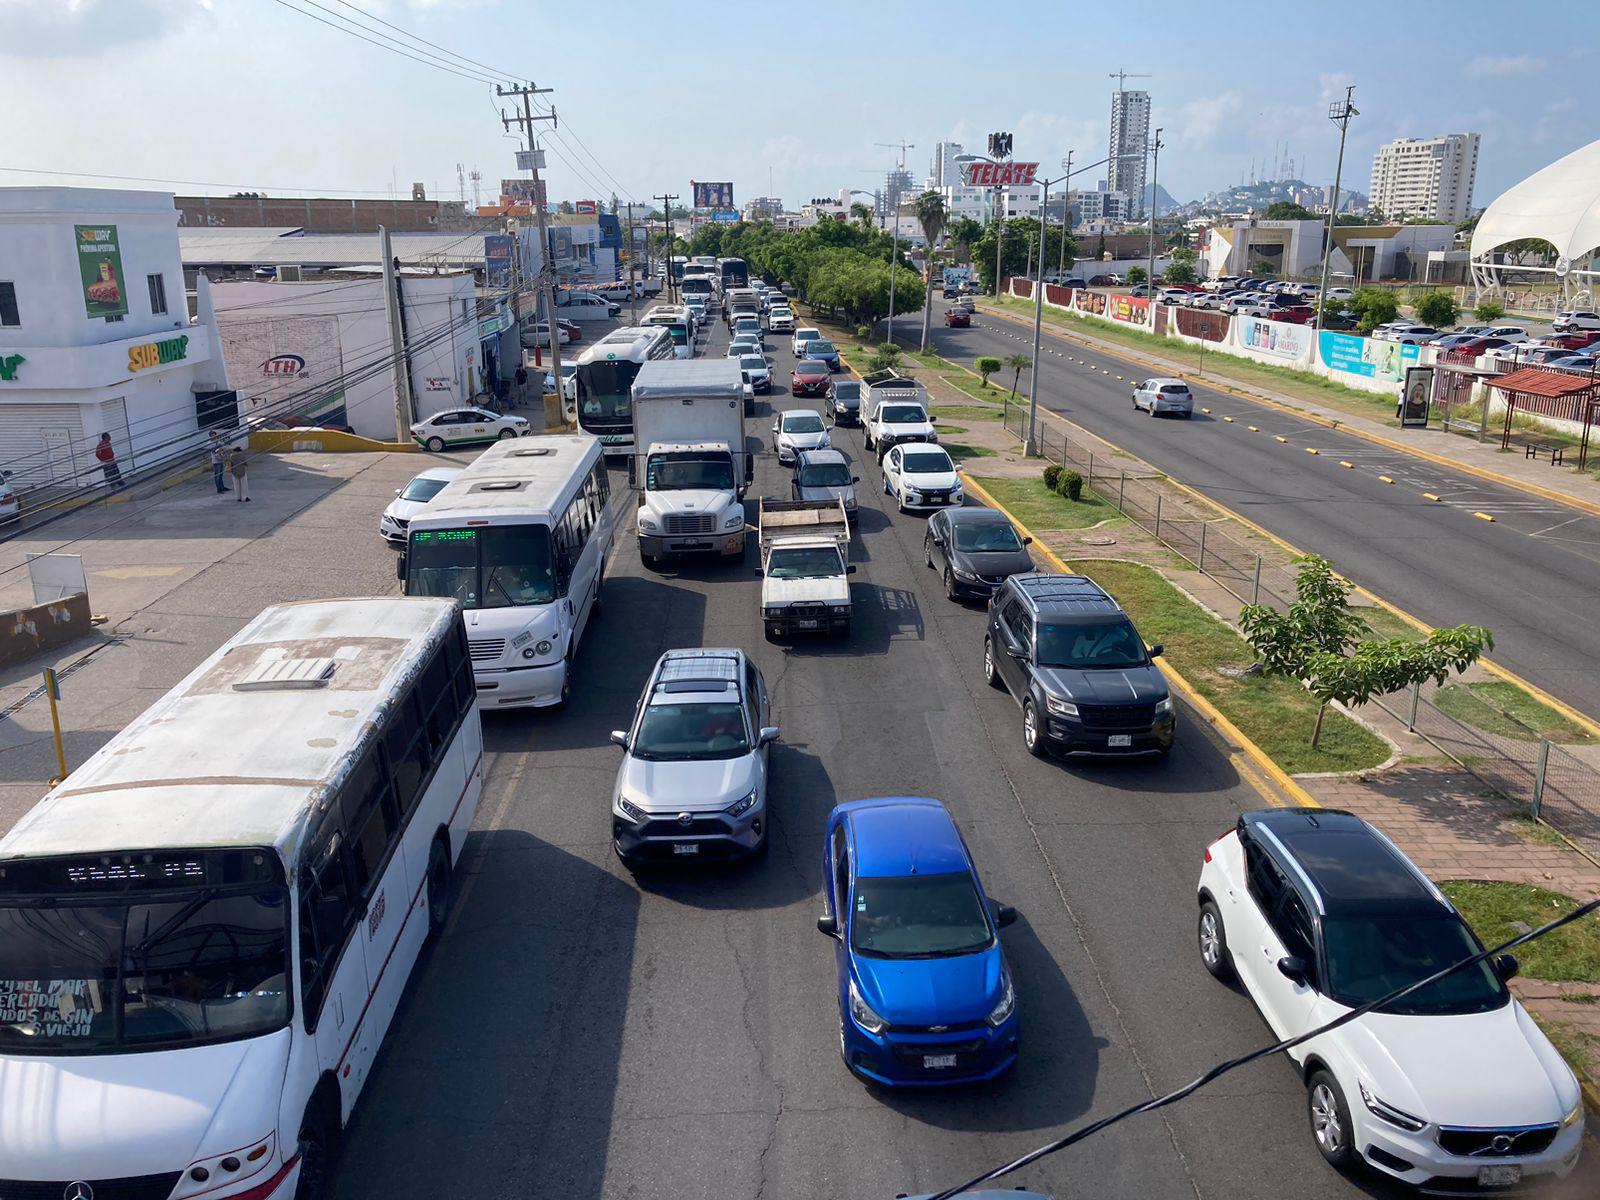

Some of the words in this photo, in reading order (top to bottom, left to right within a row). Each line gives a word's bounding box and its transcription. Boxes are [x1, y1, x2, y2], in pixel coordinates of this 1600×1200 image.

[968, 162, 1037, 184] TECATE
[128, 335, 189, 373] SUBWAY
[263, 360, 297, 373] LTH
[48, 979, 87, 998] MAR
